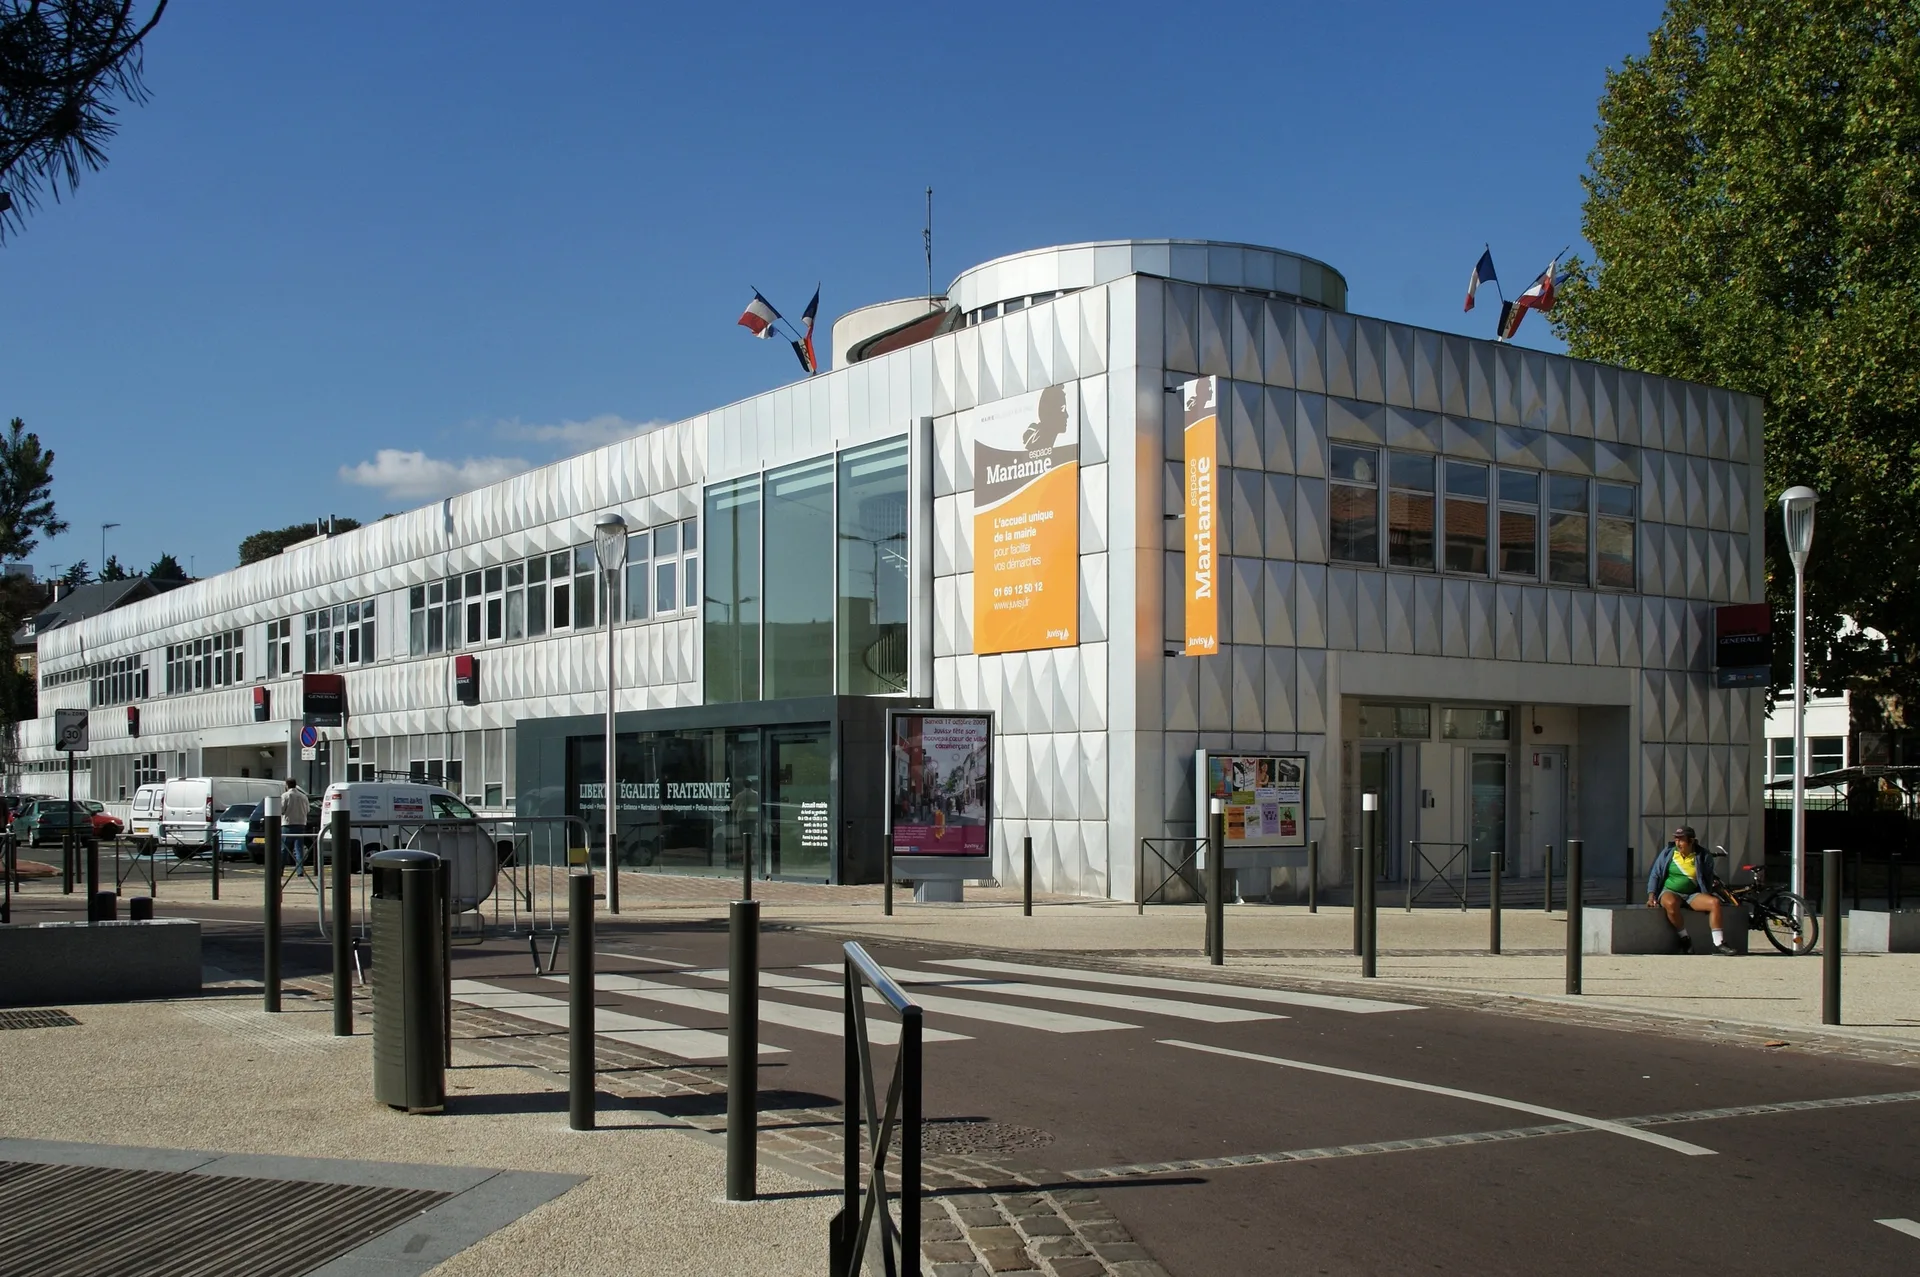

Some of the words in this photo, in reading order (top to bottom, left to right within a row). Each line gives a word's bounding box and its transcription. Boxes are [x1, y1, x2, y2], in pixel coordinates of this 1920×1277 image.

[1029, 447, 1052, 459] espace
[986, 457, 1052, 485] Marianne
[1190, 458, 1198, 507] espace
[994, 513, 1027, 529] L'accueil
[1028, 510, 1054, 524] unique
[1194, 456, 1211, 600] Marianne
[994, 532, 1003, 543] de
[1005, 530, 1012, 541] la
[1013, 527, 1037, 540] mairie
[994, 547, 1009, 559] pour
[1010, 542, 1032, 556] faciliter
[994, 562, 1005, 572] vos
[1006, 556, 1042, 570] démarches
[994, 587, 1002, 598] 01
[1003, 586, 1013, 596] 69
[1014, 584, 1023, 595] 12
[1024, 583, 1033, 593] 50
[1034, 582, 1044, 593] 12
[66, 730, 79, 740] 30
[579, 783, 607, 799] LIBERT
[620, 778, 660, 799] ÉGALITÉ
[667, 777, 731, 799] FRATERNITÉ
